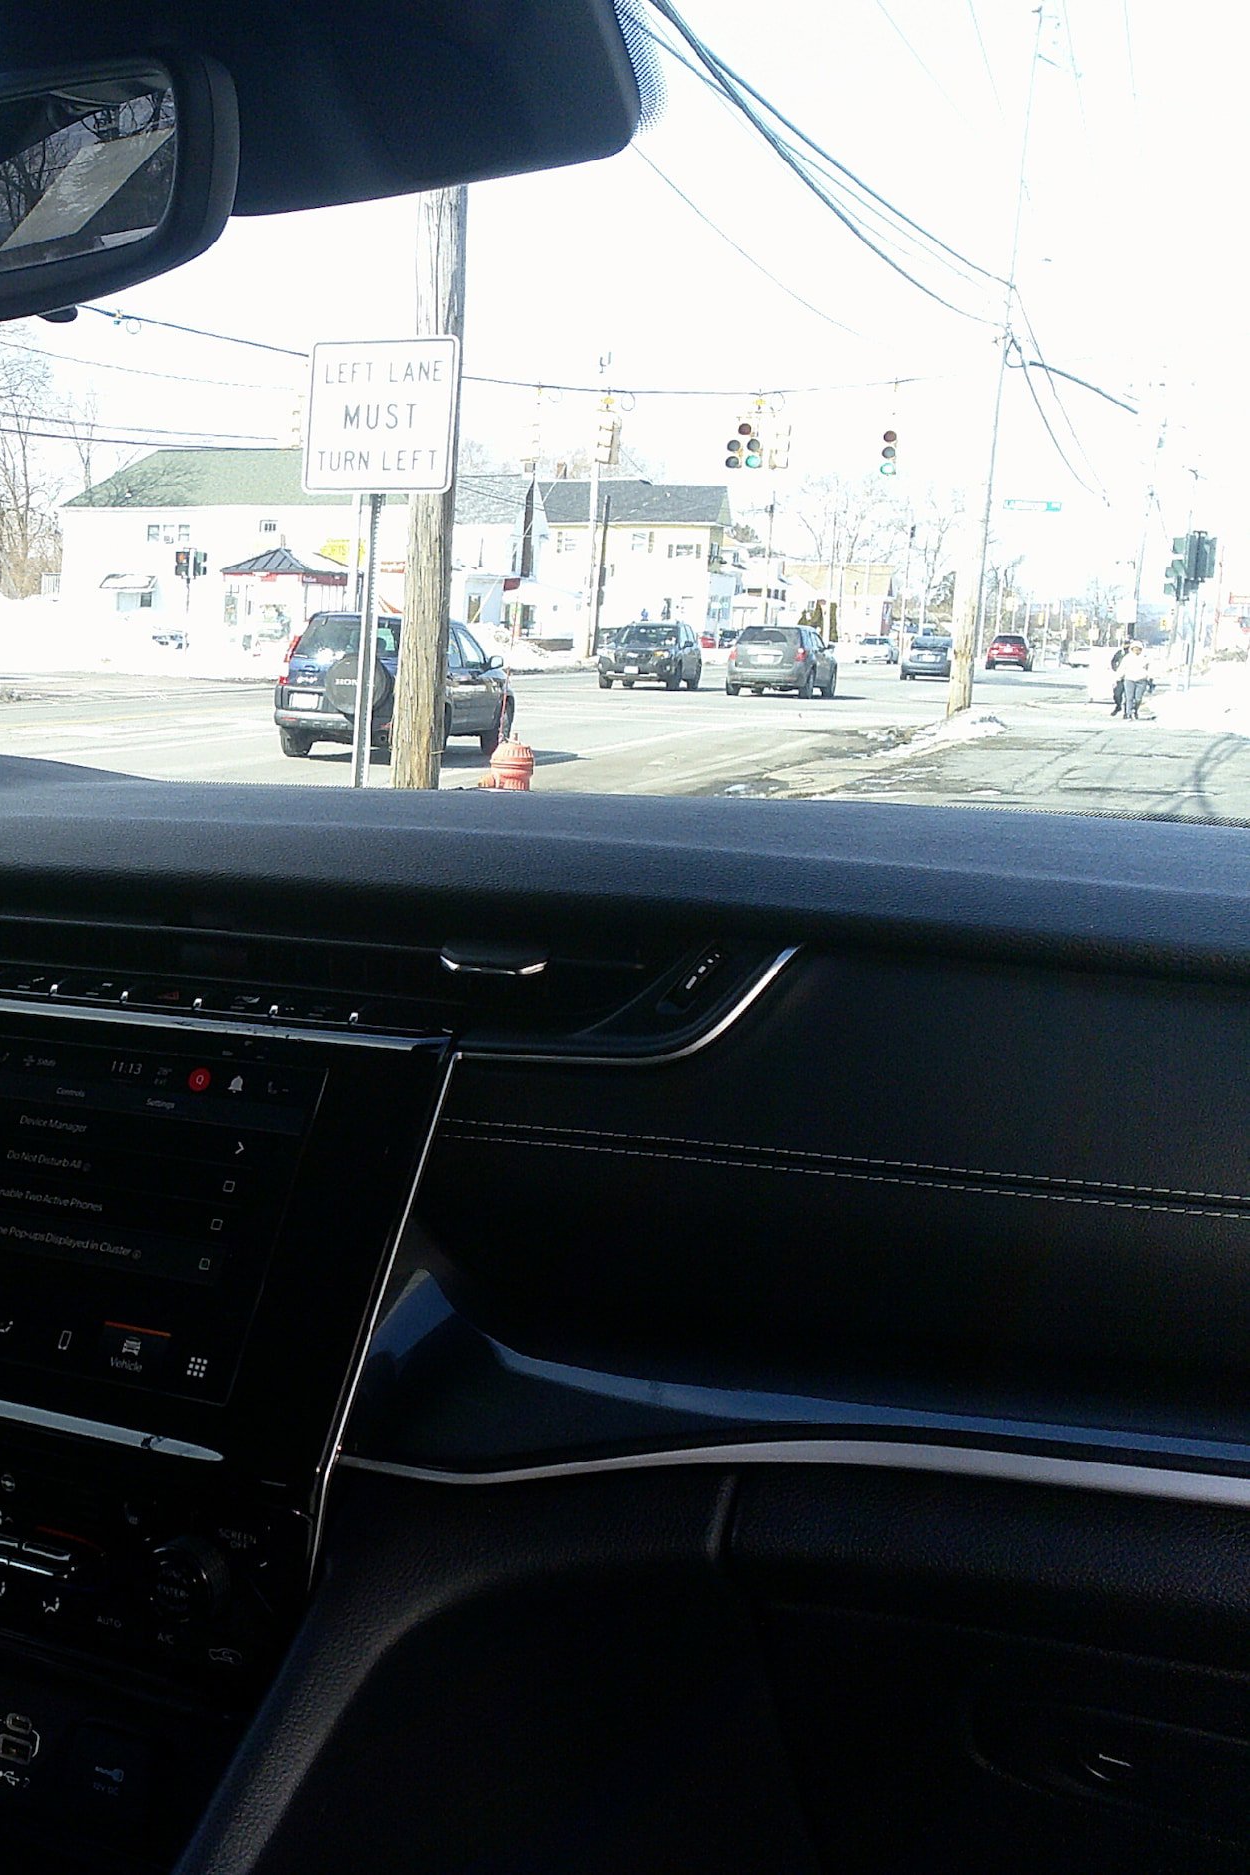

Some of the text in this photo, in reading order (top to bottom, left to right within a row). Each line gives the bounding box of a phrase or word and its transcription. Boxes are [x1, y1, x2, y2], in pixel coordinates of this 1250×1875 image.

[324, 359, 444, 386] LEFT LANE
[343, 403, 418, 431] MUST
[317, 448, 438, 472] TURN LEFT
[111, 1060, 143, 1076] 11:13
[56, 1086, 86, 1099] Controls
[146, 1096, 176, 1110] Settings
[20, 1114, 88, 1134] Device Manager
[6, 1149, 83, 1170] Do Not Disturb All
[25, 1190, 42, 1202] Two
[42, 1194, 70, 1207] Active
[70, 1197, 104, 1212] Phones
[8, 1226, 45, 1242] Pop-ups
[45, 1232, 90, 1251] Displayed
[90, 1240, 99, 1250] in
[100, 1241, 132, 1257] Cluster
[110, 1356, 144, 1374] Vehicle
[218, 1527, 258, 1545] SCREEN
[96, 1615, 122, 1629] AUTO
